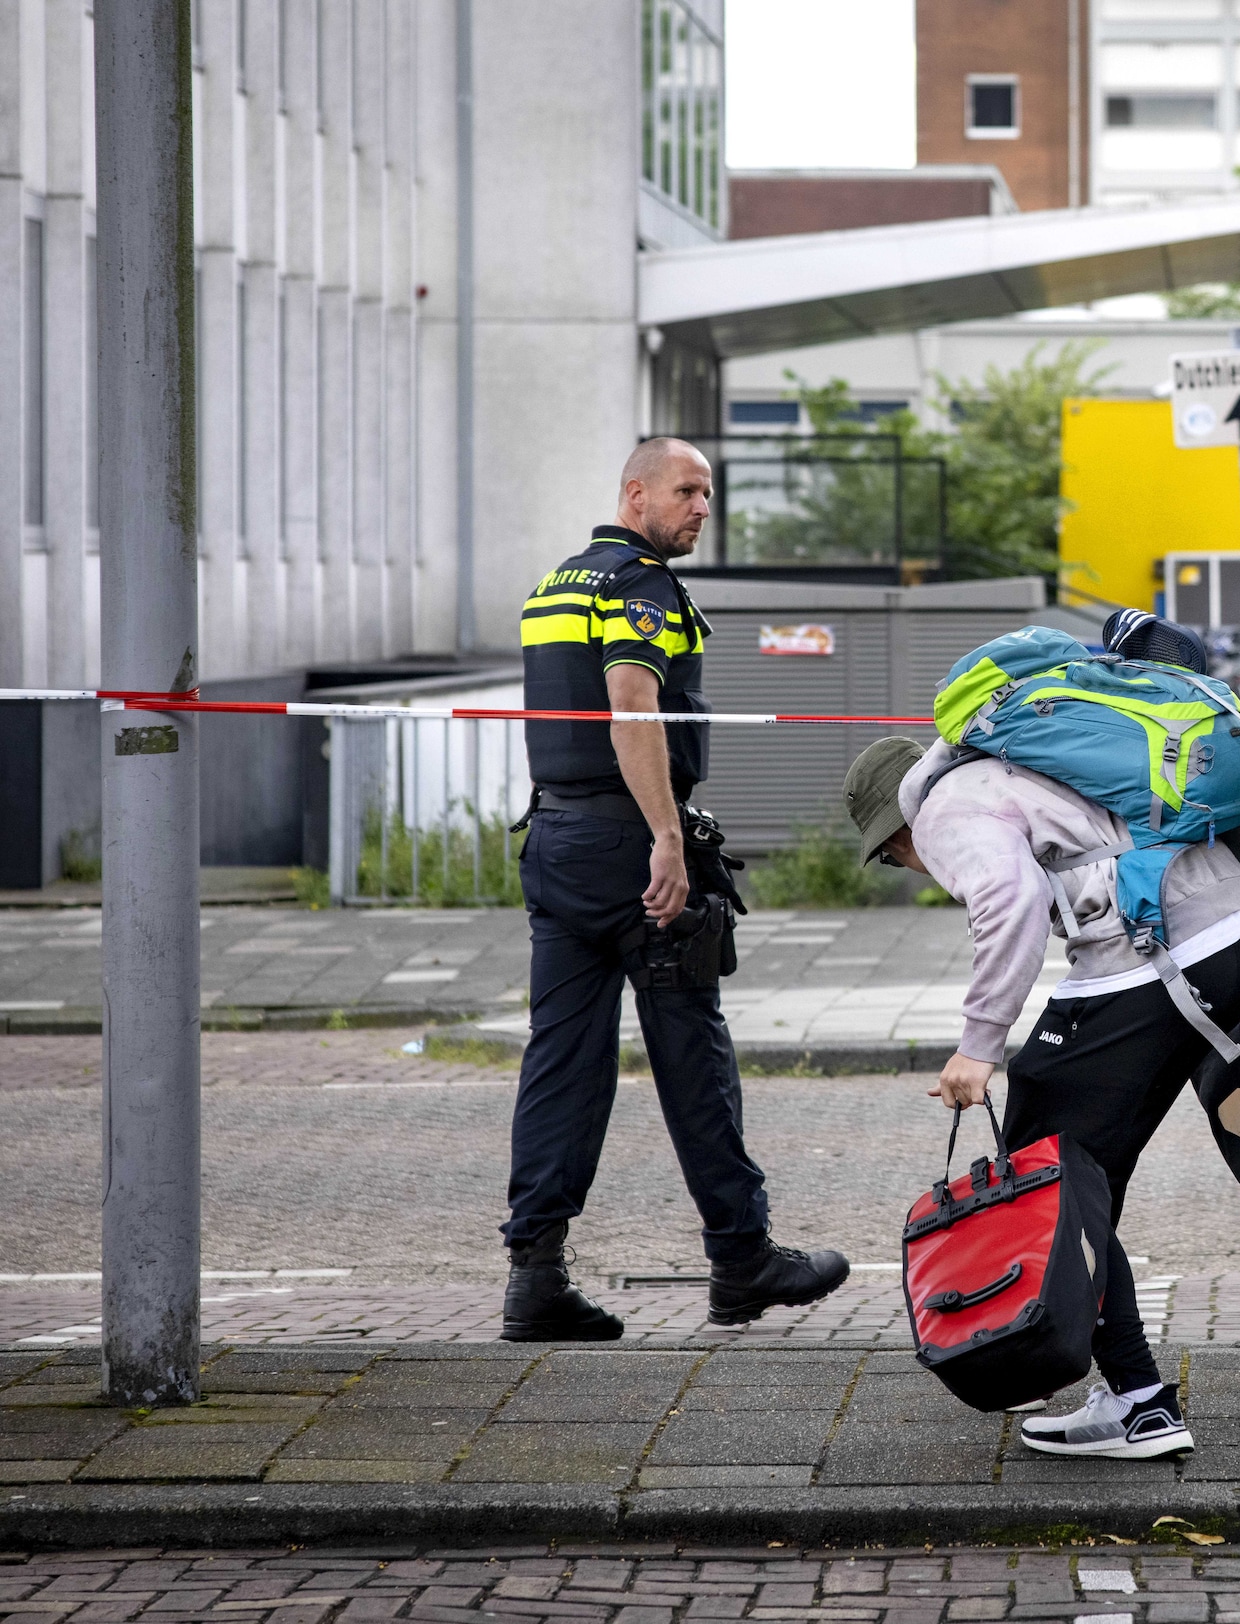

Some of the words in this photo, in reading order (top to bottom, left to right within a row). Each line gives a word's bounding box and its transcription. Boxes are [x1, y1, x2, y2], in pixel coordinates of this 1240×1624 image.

[537, 568, 591, 596] OLITIE
[630, 603, 662, 618] POLITIE
[1039, 1030, 1063, 1046] JAKO
